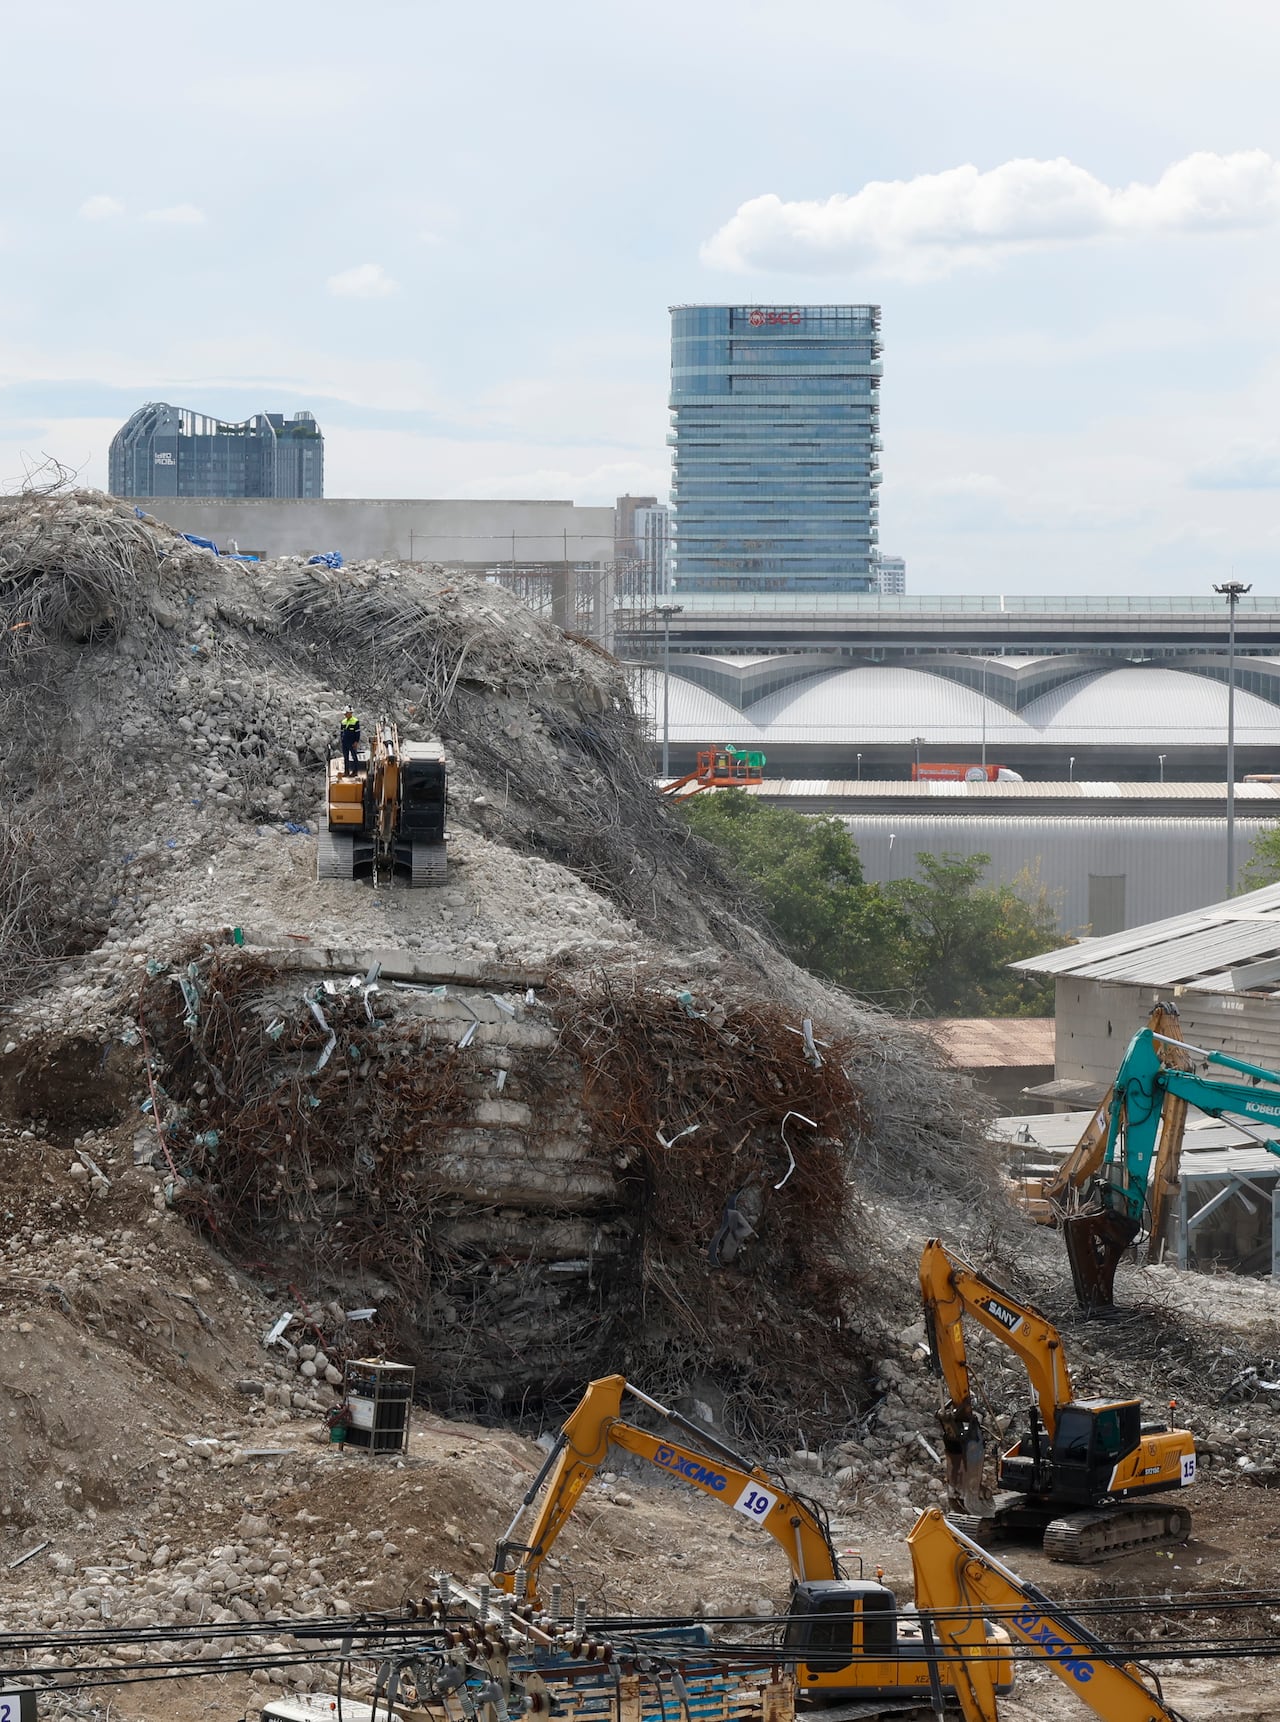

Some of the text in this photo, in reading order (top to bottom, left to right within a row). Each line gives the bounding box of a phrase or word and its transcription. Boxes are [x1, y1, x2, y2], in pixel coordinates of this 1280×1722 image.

[767, 311, 800, 325] SCG
[988, 1301, 1016, 1326] SANY
[671, 1456, 728, 1492] XCMG
[1183, 1460, 1194, 1478] 15
[743, 1491, 769, 1515] 19
[1028, 1623, 1094, 1683] XCMG
[0, 1704, 12, 1722] 2
